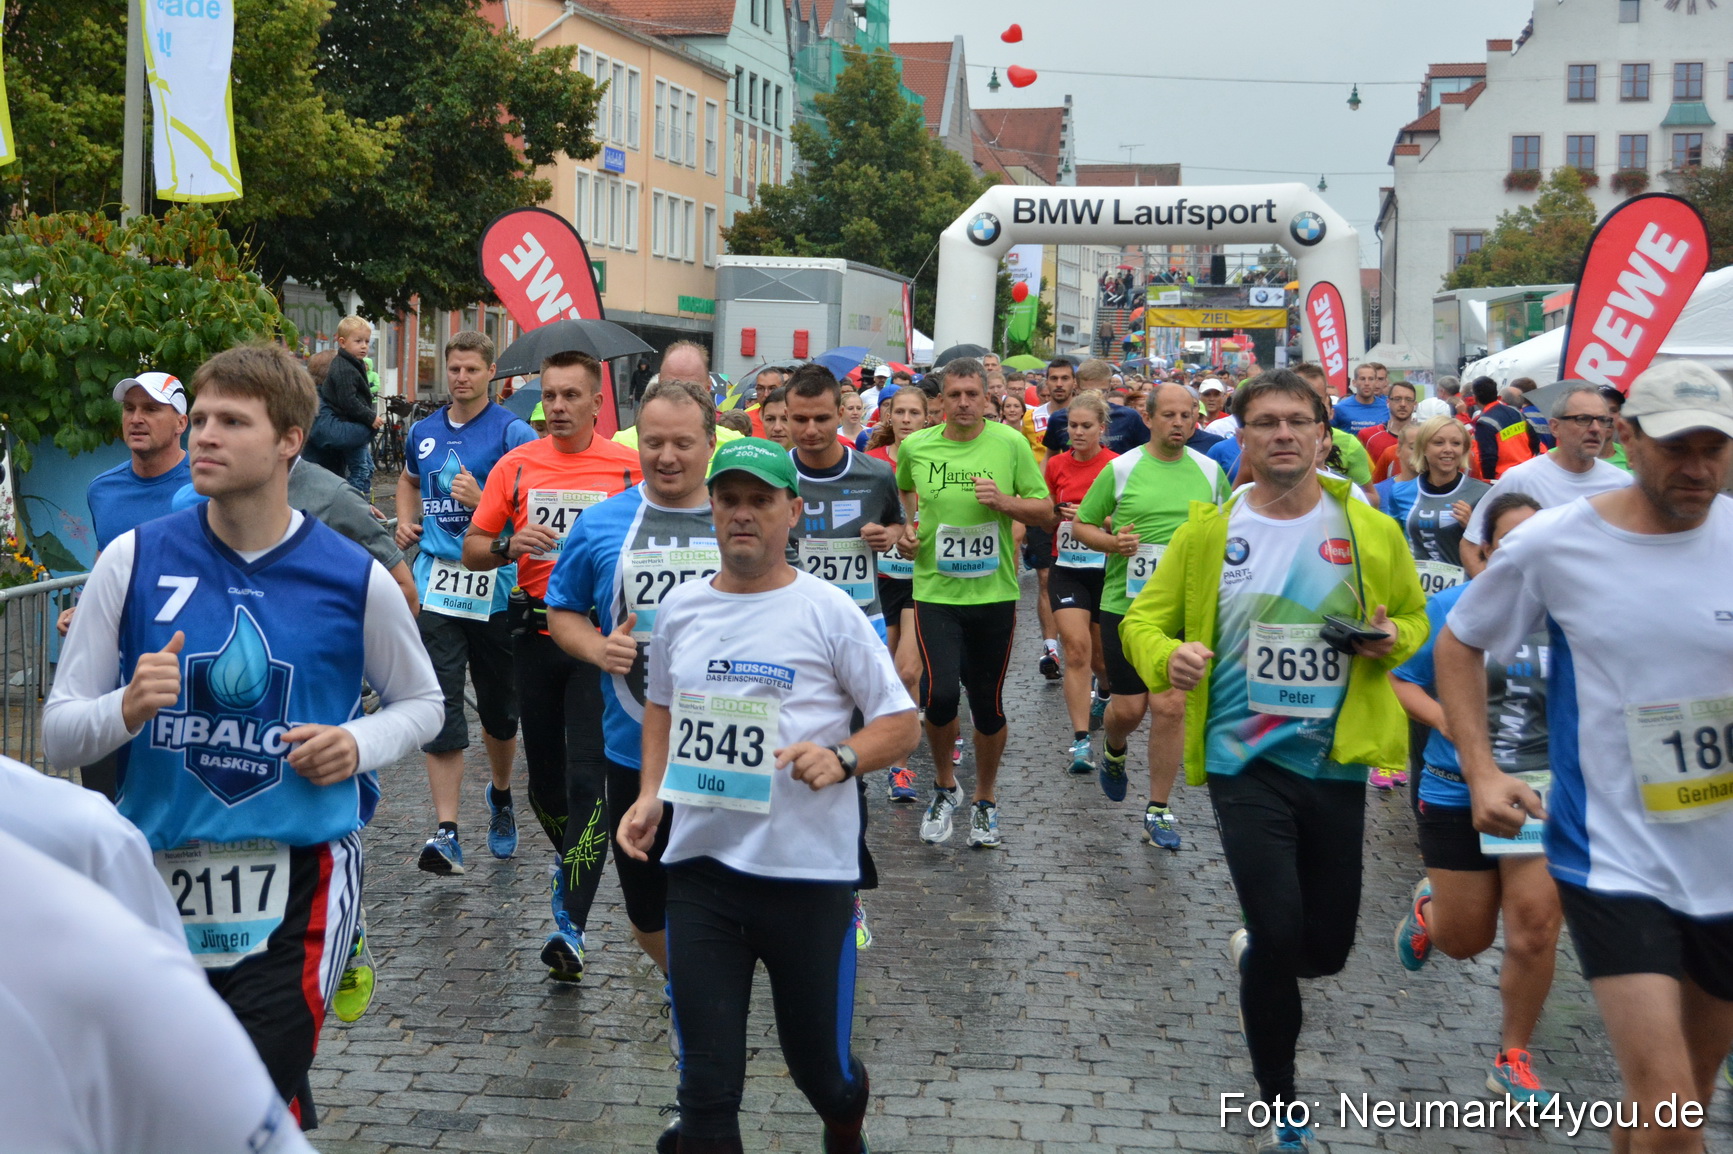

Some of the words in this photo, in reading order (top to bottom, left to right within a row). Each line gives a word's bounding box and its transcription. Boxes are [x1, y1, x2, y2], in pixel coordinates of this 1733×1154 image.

[1013, 197, 1104, 225] BMW
[1113, 198, 1277, 230] Laufsport
[1574, 222, 1689, 387] REWE
[1201, 312, 1232, 325] ZIEL
[418, 438, 436, 460] 9
[735, 450, 759, 458] 2003
[669, 550, 720, 563] BOCK
[943, 535, 994, 558] 2149
[807, 554, 868, 581] 2579
[951, 562, 985, 572] Michael
[1071, 554, 1087, 563] Anja
[435, 569, 489, 597] 2118
[154, 575, 199, 621] 7
[443, 598, 473, 610] Roland
[1256, 646, 1341, 682] 2638
[723, 675, 793, 691] FEINSCHNEIDTEAM
[711, 697, 768, 716] BOCK
[1279, 690, 1316, 704] Peter
[677, 717, 766, 768] 2543
[200, 754, 269, 775] BASKETS
[697, 772, 726, 792] Udo
[165, 851, 202, 859] NeuerMarkt
[171, 863, 277, 917] 2117
[201, 929, 250, 952] Jürgen
